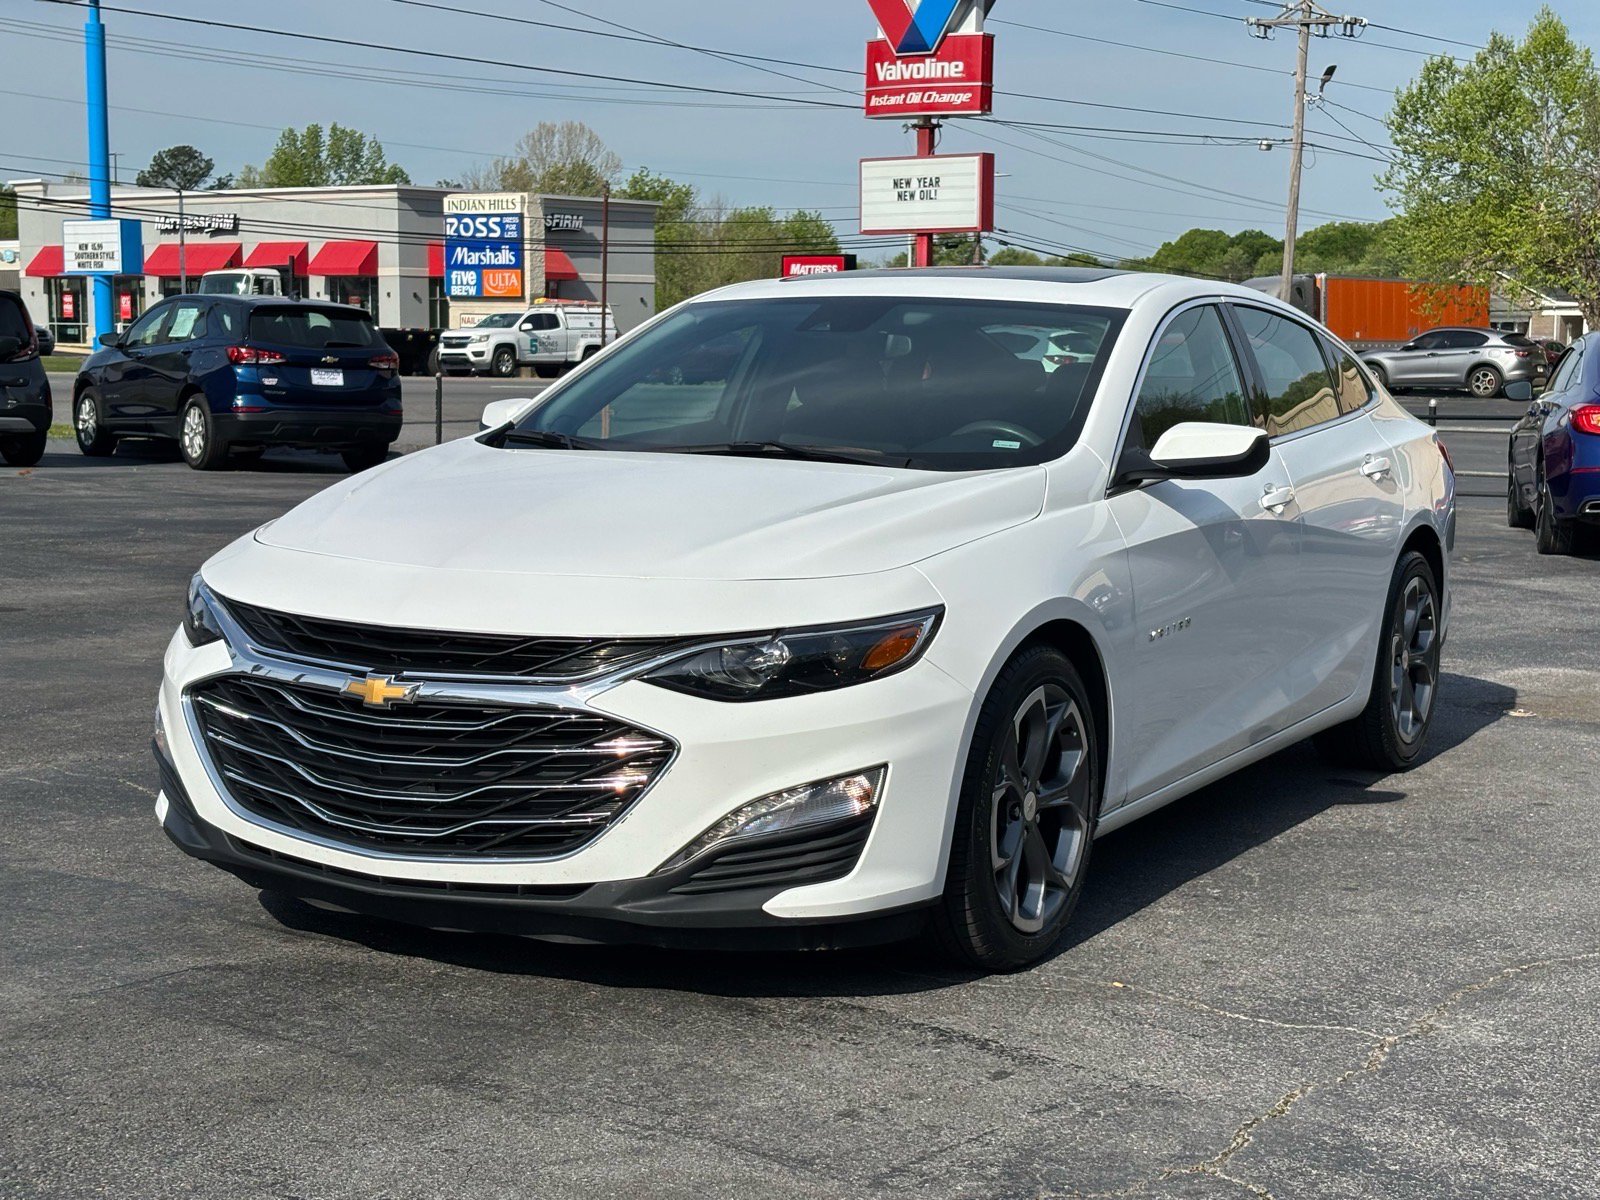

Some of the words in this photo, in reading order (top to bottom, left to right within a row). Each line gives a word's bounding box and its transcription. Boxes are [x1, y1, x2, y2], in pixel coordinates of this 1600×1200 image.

[875, 59, 964, 81] Valvoline
[869, 94, 905, 106] Instant
[906, 92, 922, 104] Oil
[922, 91, 973, 105] Change
[893, 177, 912, 189] NEW
[916, 176, 941, 188] YEAR
[897, 190, 916, 201] NEW
[919, 189, 938, 200] OIL!
[447, 199, 486, 211] INDIAN
[488, 198, 517, 210] HILLS
[446, 217, 501, 238] ROSS
[99, 251, 115, 260] STYLE
[451, 245, 516, 265] Marshalls
[790, 263, 838, 275] MATTRESS
[489, 273, 518, 287] ULTA
[529, 338, 538, 354] 5
